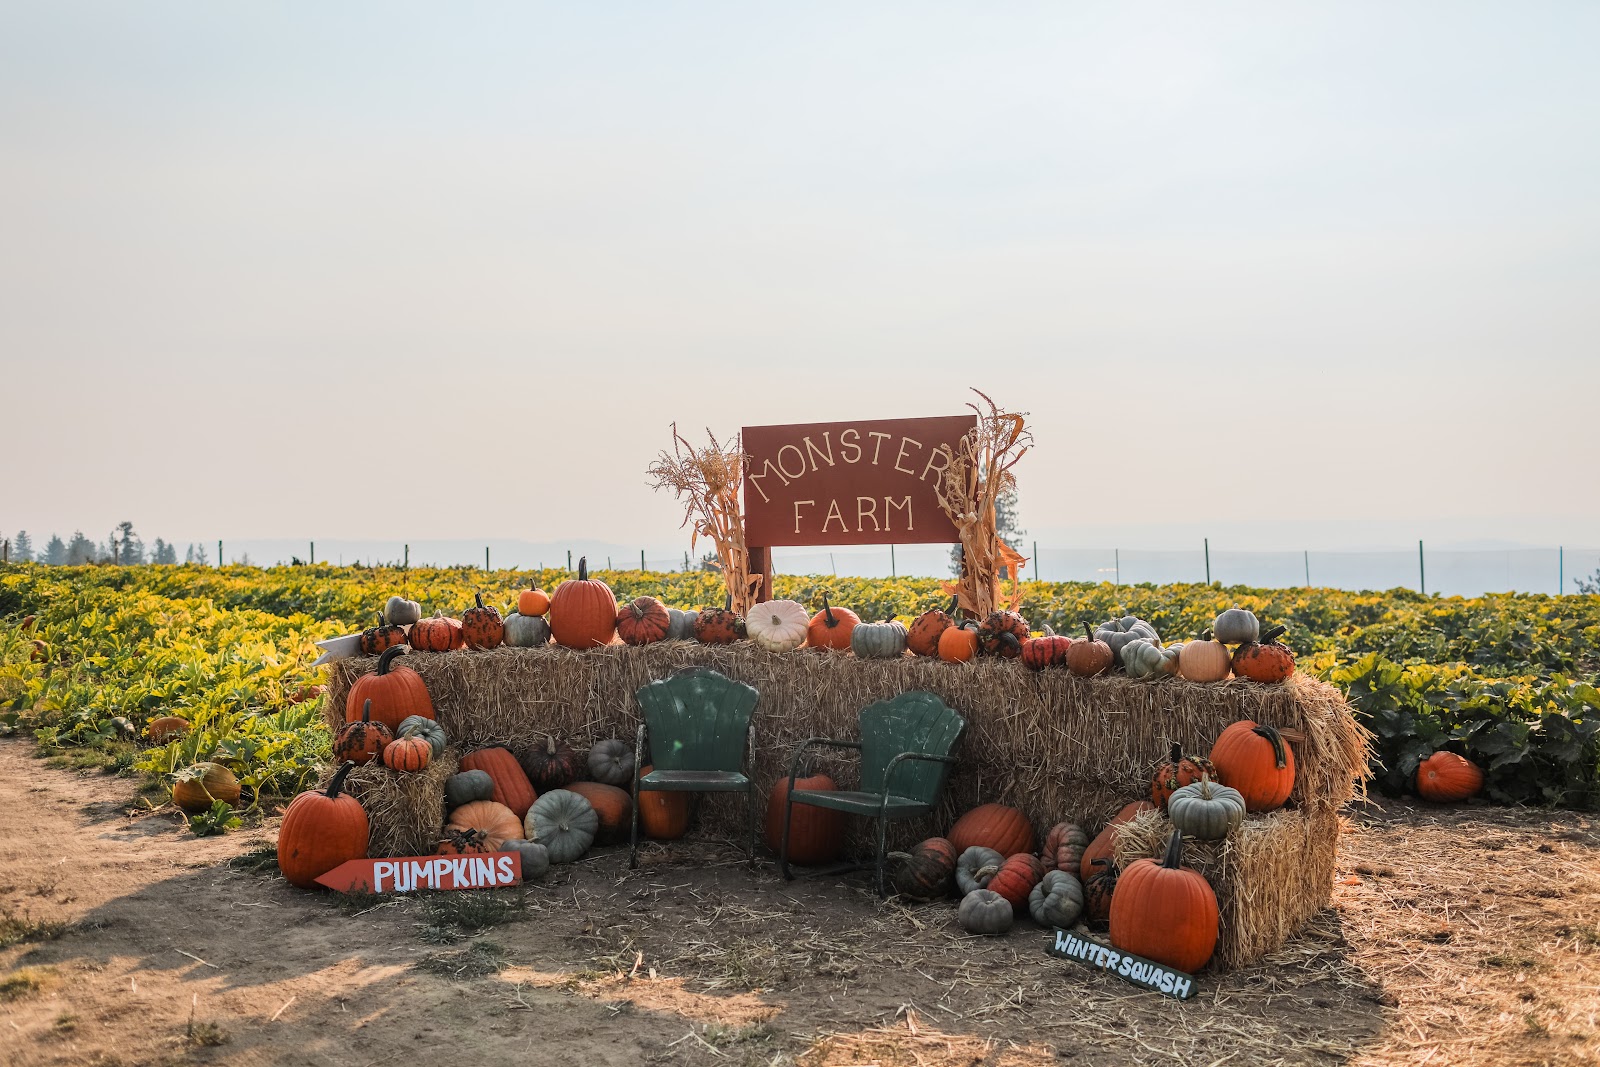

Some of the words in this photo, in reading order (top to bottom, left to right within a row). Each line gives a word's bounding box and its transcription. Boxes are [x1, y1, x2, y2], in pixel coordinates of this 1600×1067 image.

[748, 429, 950, 502] MONSTER
[794, 496, 914, 533] FARM
[374, 856, 514, 892] PUMPKINS
[1118, 956, 1191, 998] SQUASH
